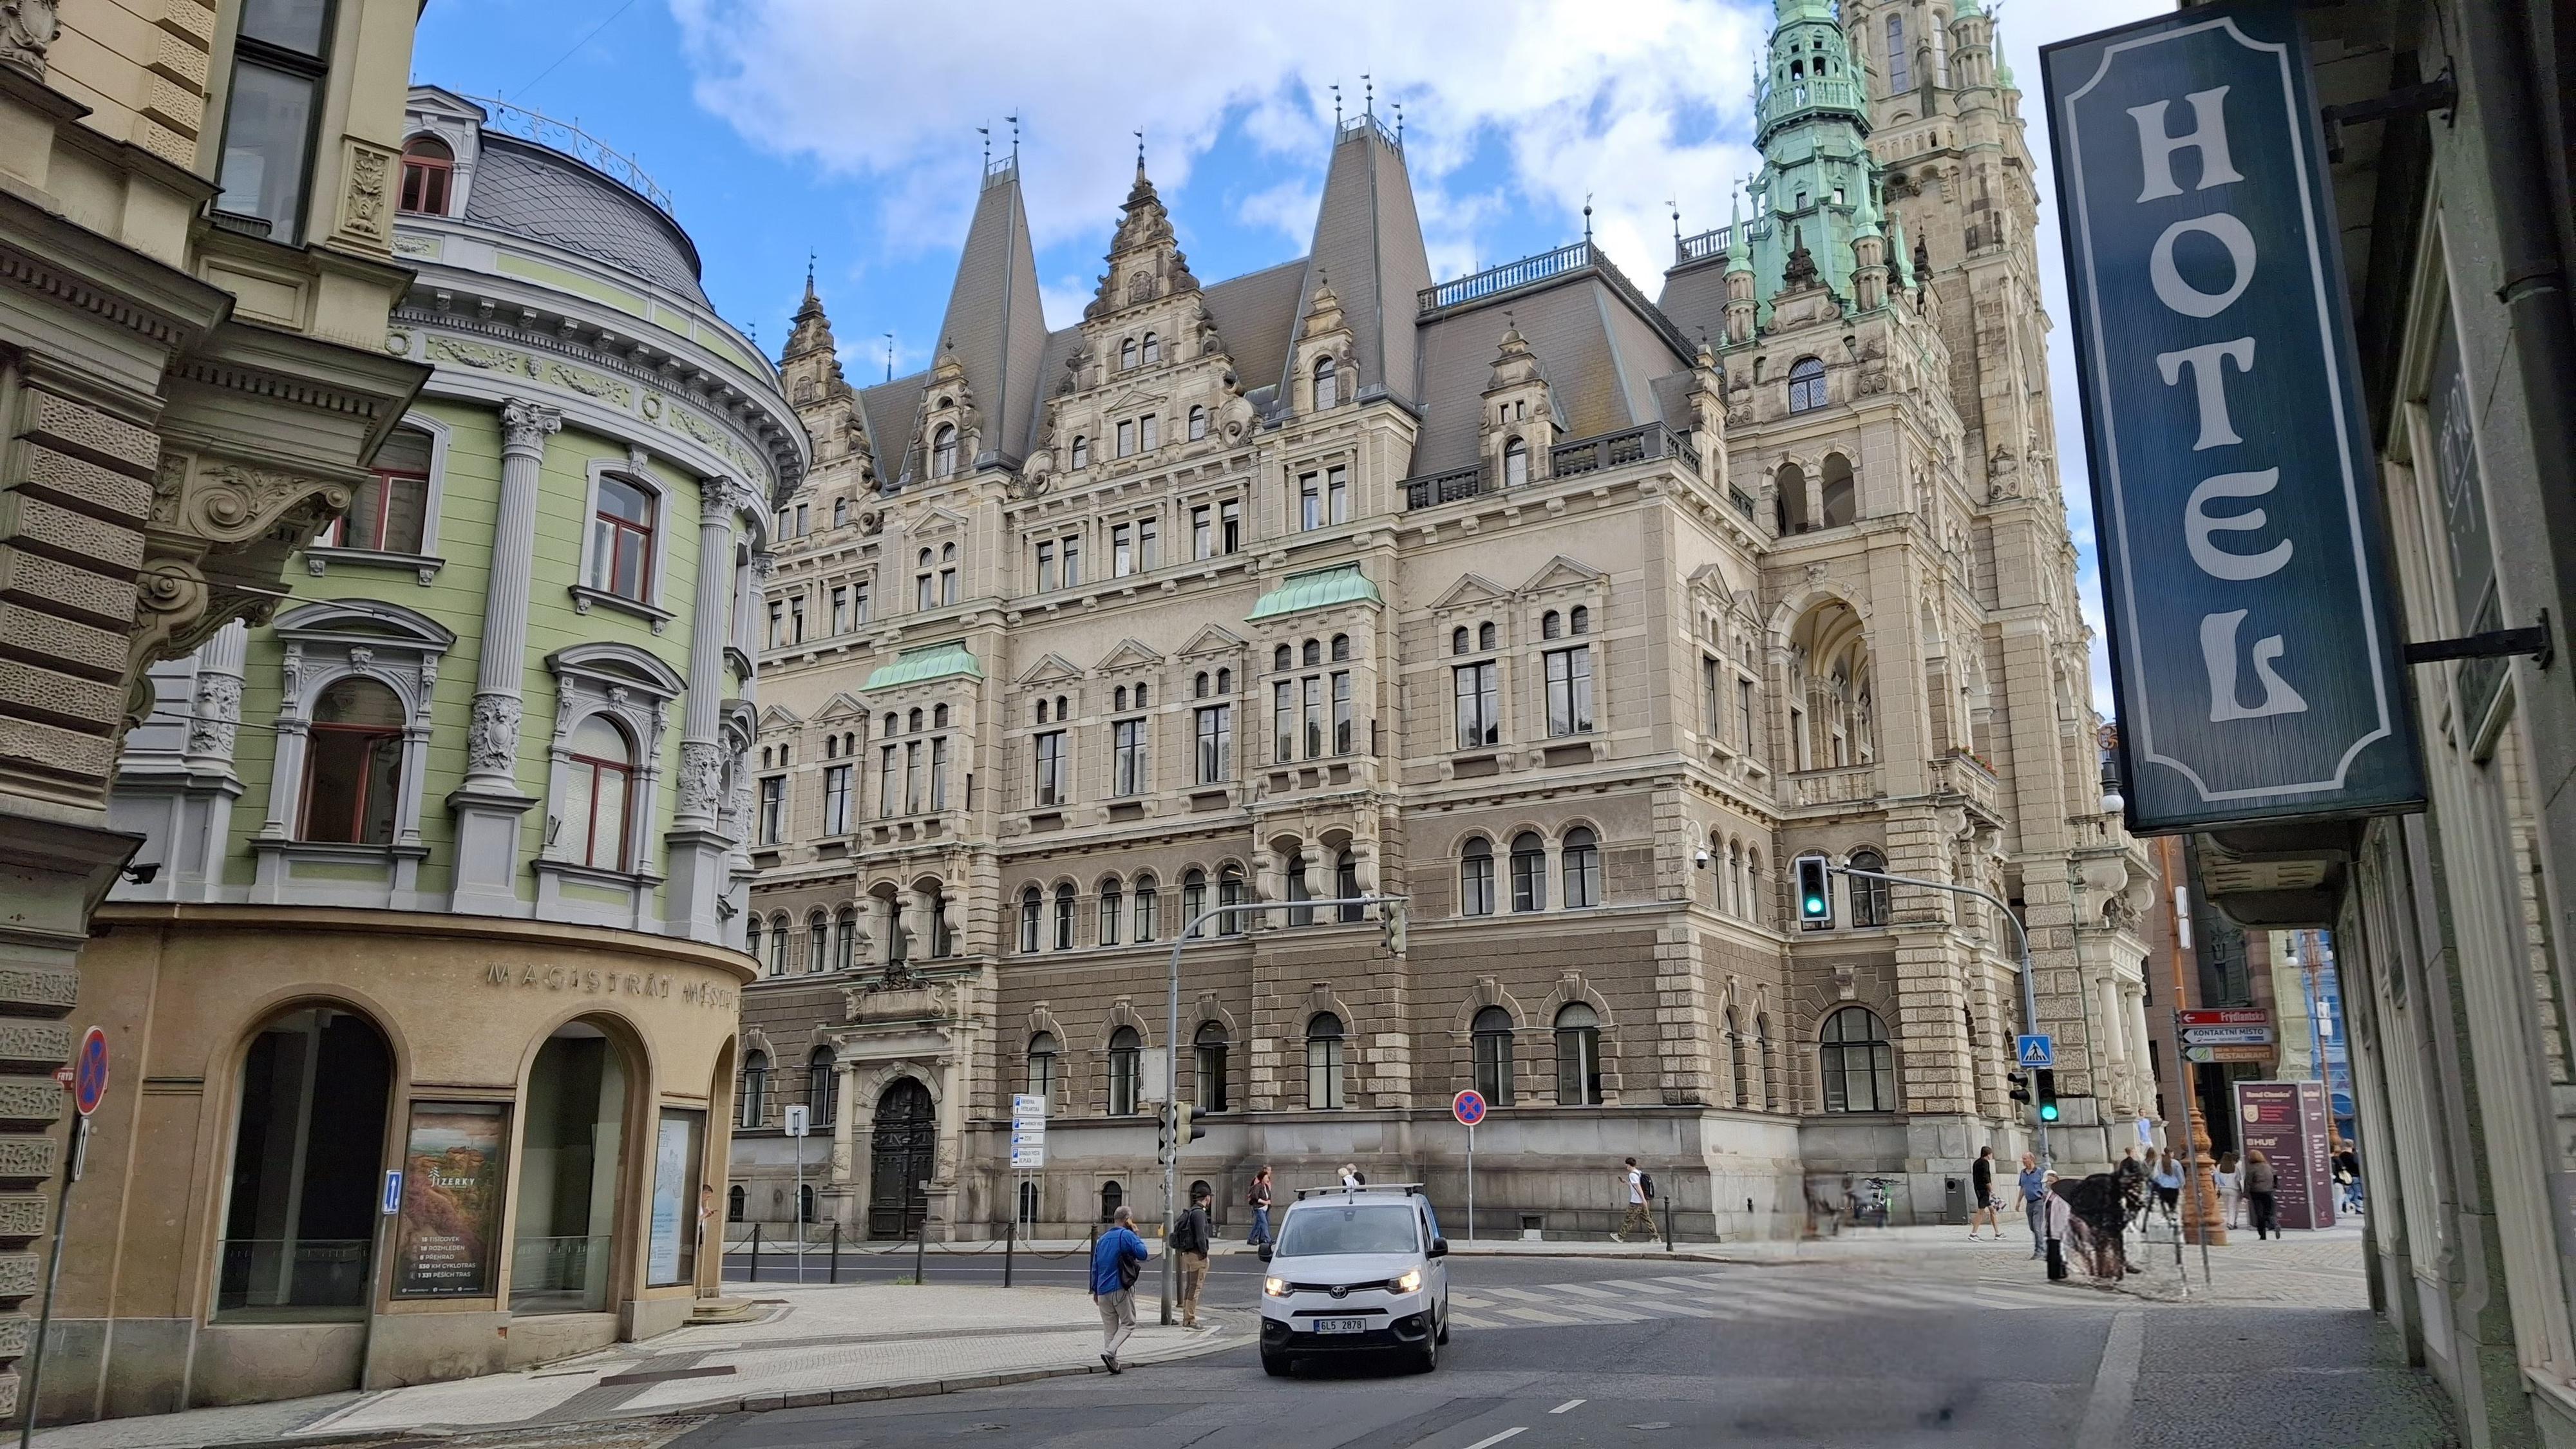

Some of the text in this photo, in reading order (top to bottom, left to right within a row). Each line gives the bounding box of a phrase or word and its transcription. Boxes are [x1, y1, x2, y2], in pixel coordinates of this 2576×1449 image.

[2125, 84, 2309, 723] HOTEL
[487, 961, 669, 999] MAGISTRÁT
[1321, 1321, 1336, 1331] 6L5
[1342, 1320, 1361, 1330] 2878
